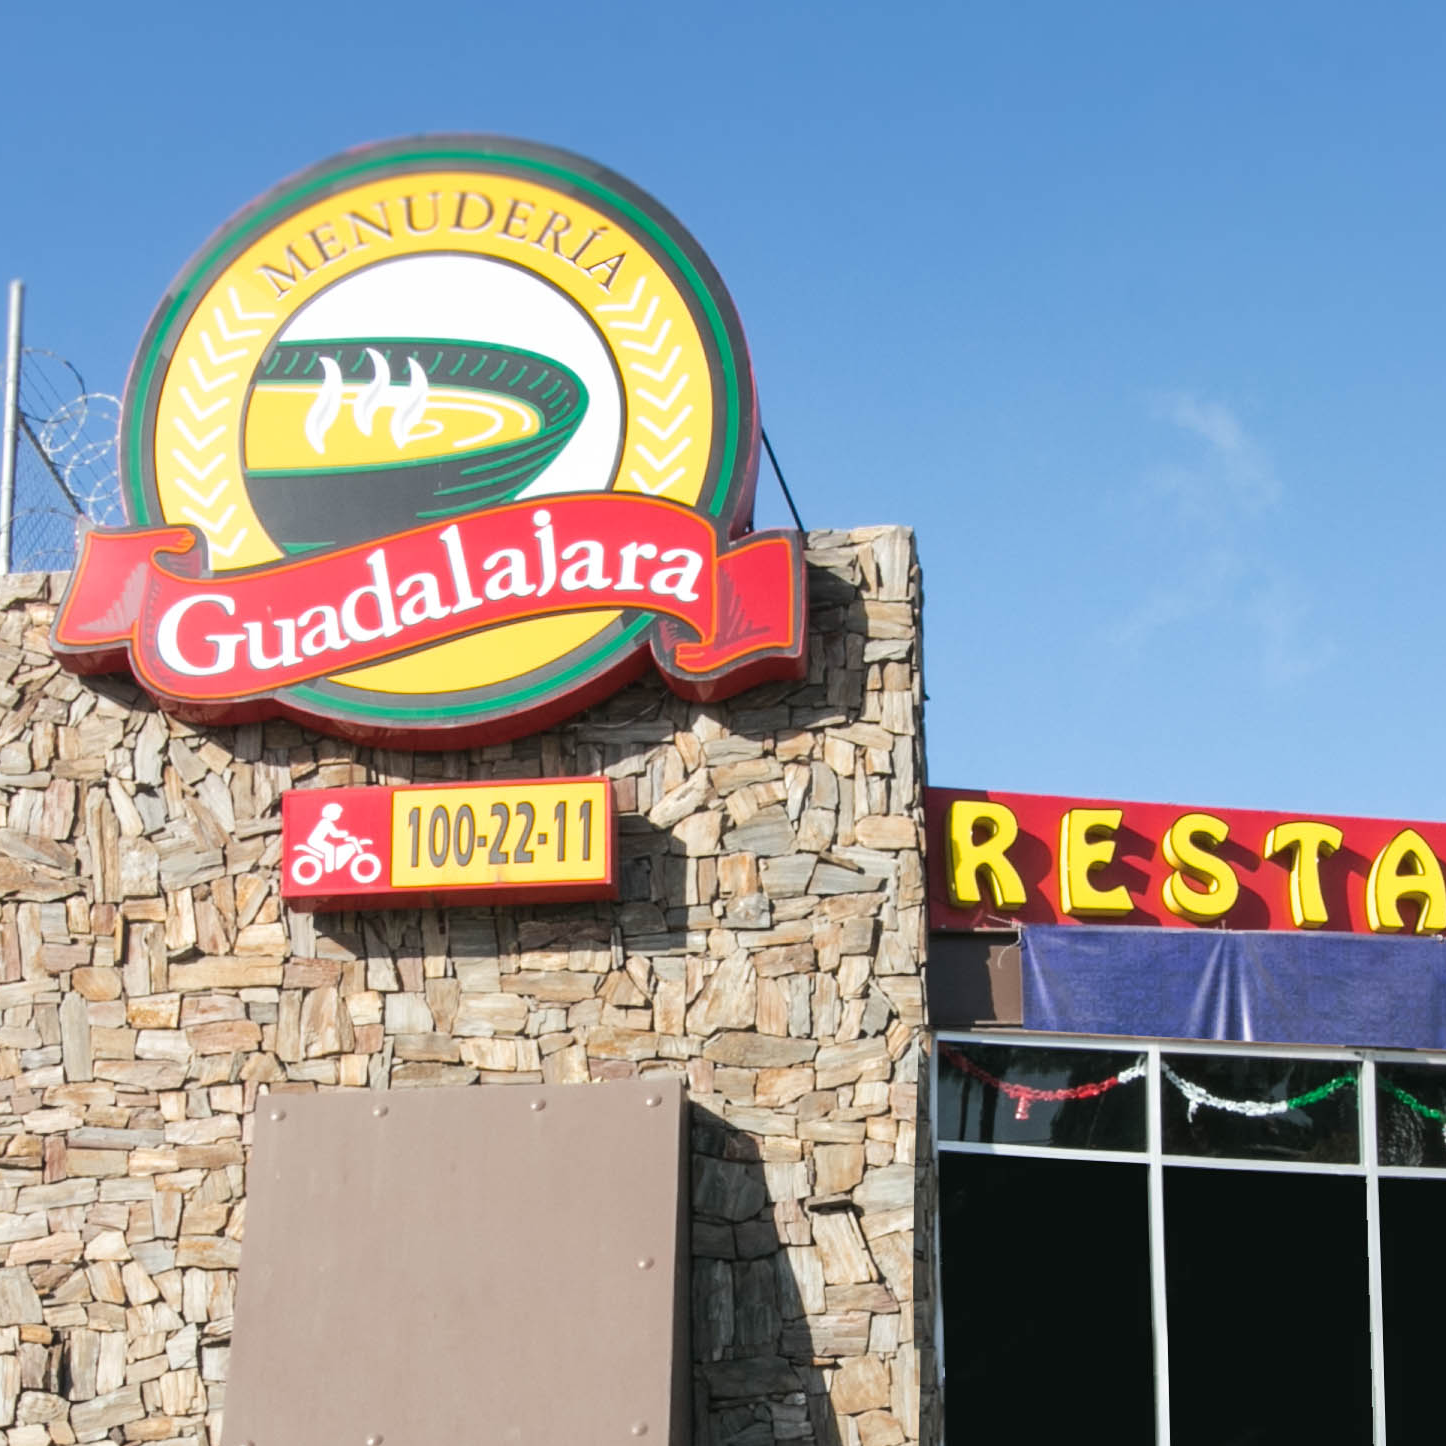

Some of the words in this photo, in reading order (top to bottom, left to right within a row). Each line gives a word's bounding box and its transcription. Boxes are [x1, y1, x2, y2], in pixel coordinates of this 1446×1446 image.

[254, 189, 629, 300] MENUDERÍA
[155, 509, 704, 678] Guadalajara
[407, 799, 593, 869] 100-22-11
